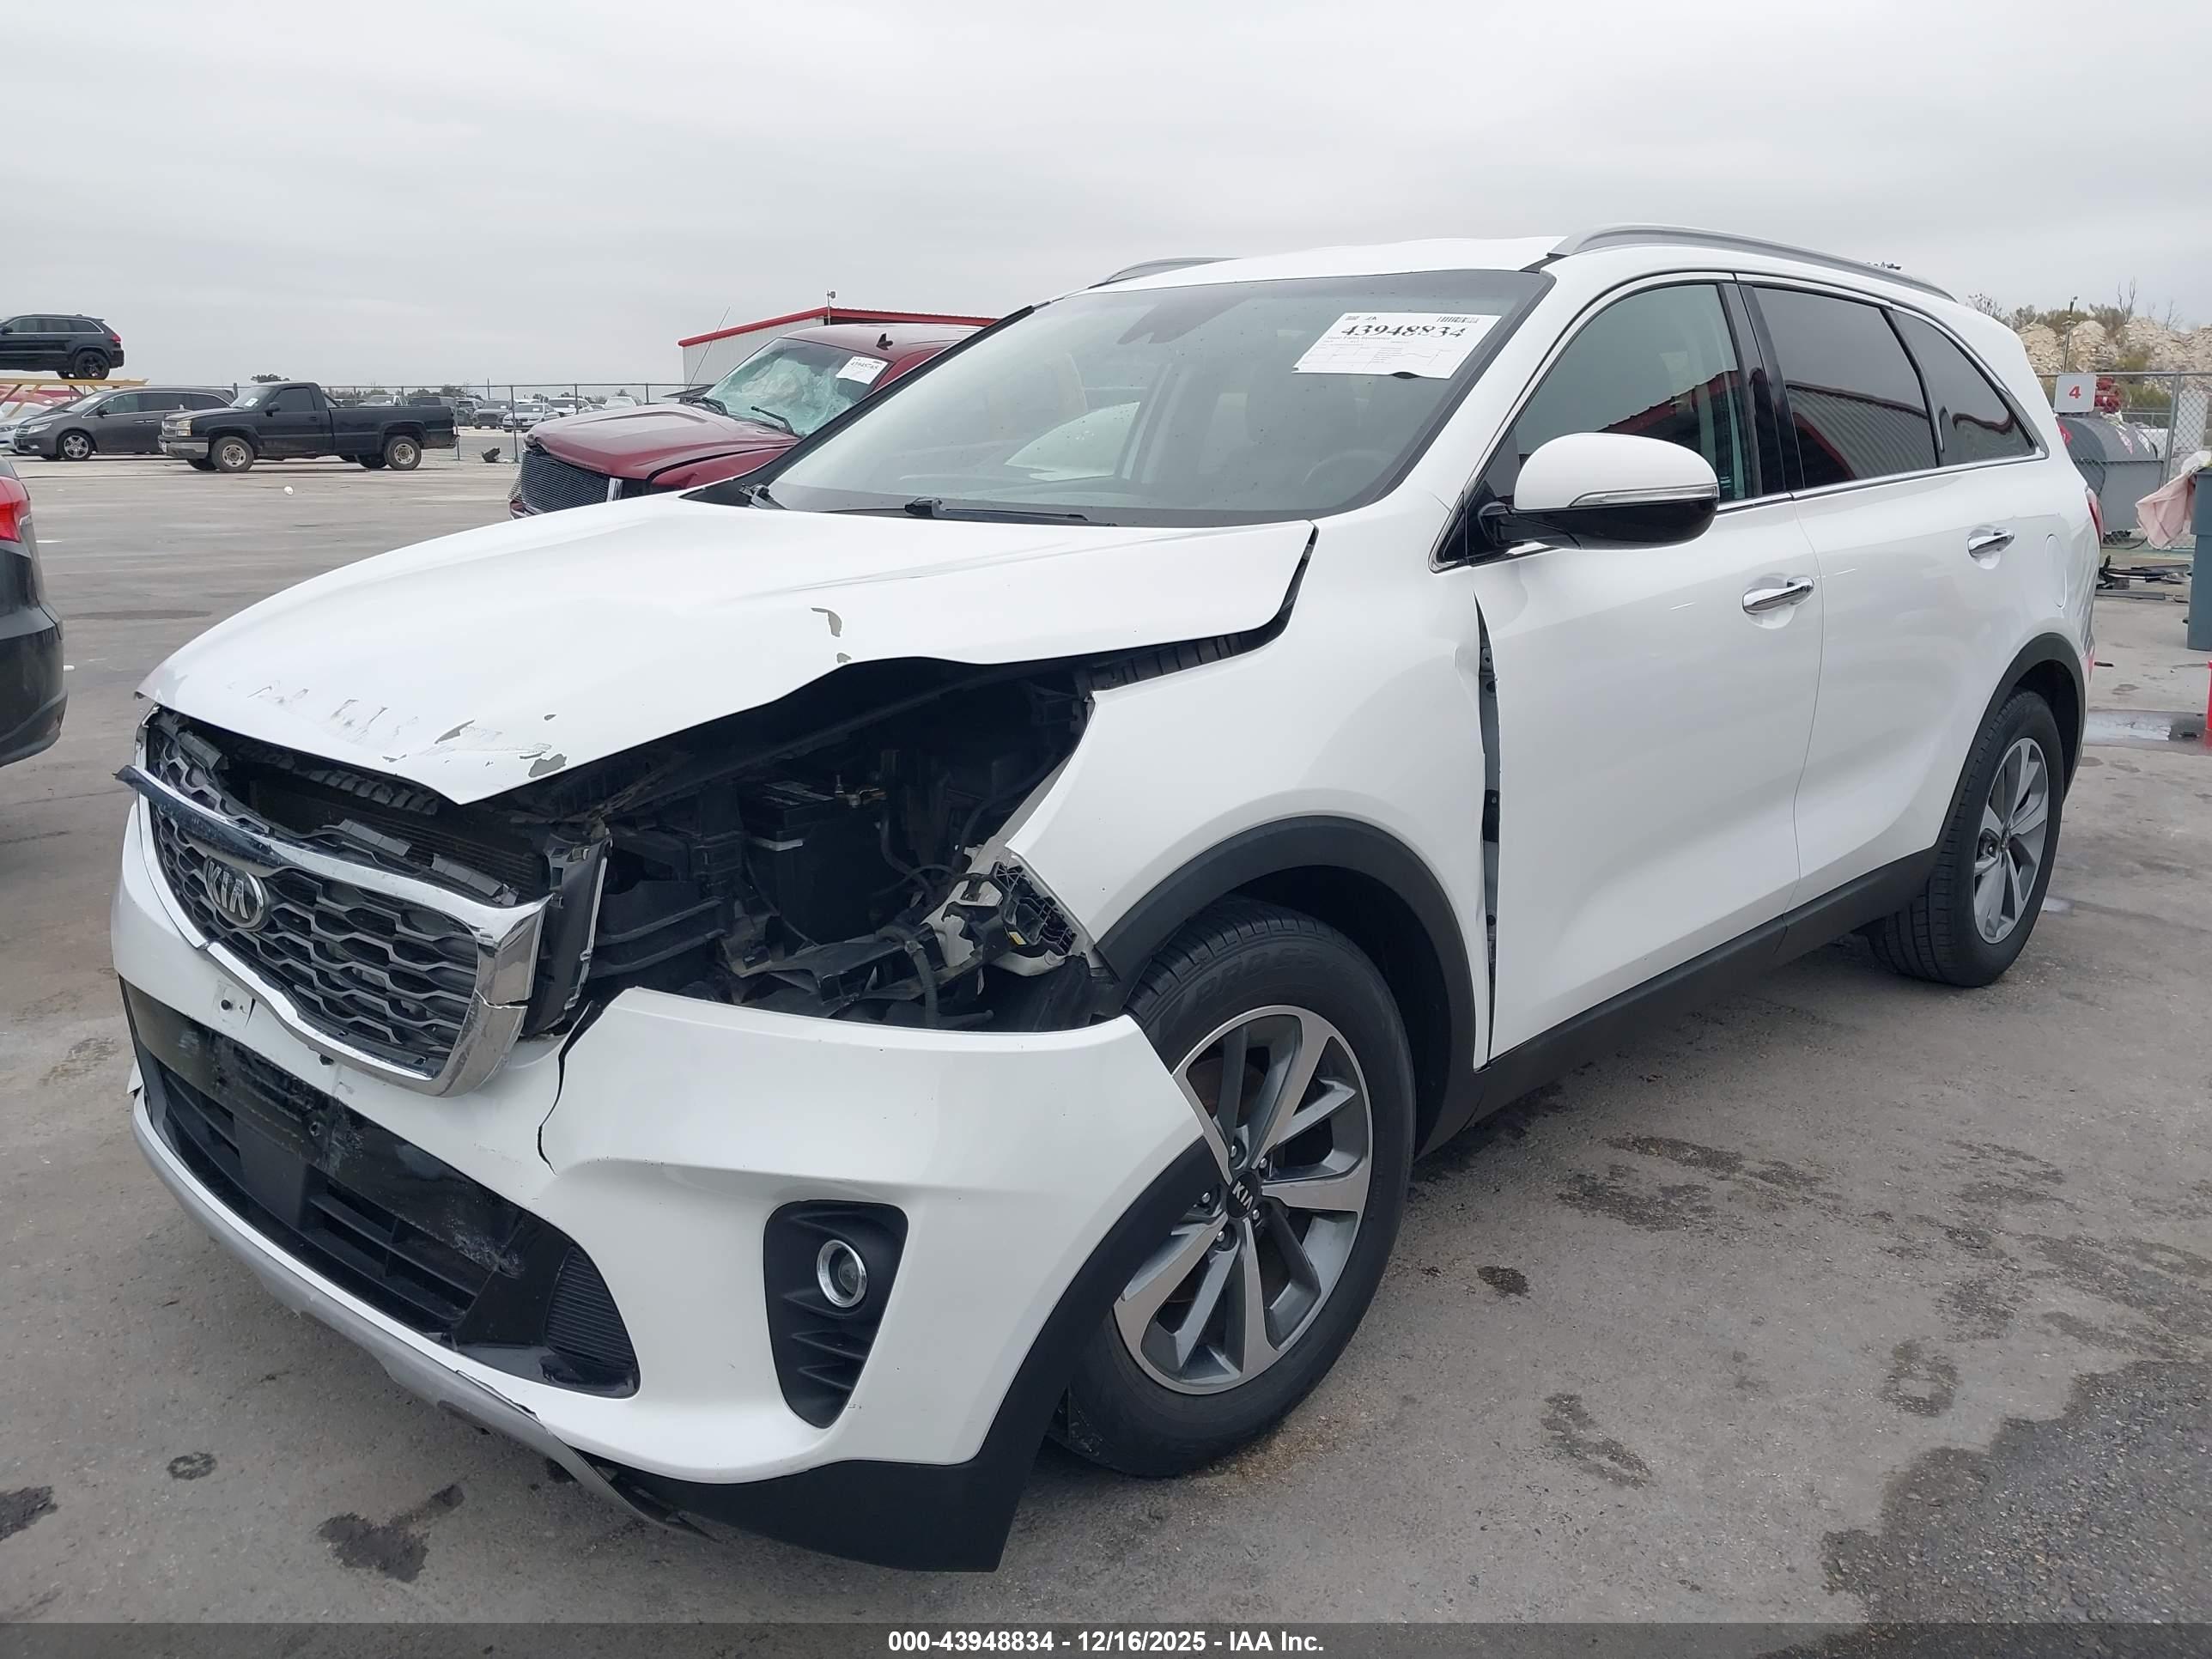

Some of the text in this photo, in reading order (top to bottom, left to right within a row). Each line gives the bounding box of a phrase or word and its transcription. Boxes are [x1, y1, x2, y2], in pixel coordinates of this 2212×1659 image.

[1340, 324, 1468, 338] 43948834
[2069, 385, 2081, 399] 4
[207, 860, 249, 920] KIA
[1231, 1180, 1254, 1211] KIA
